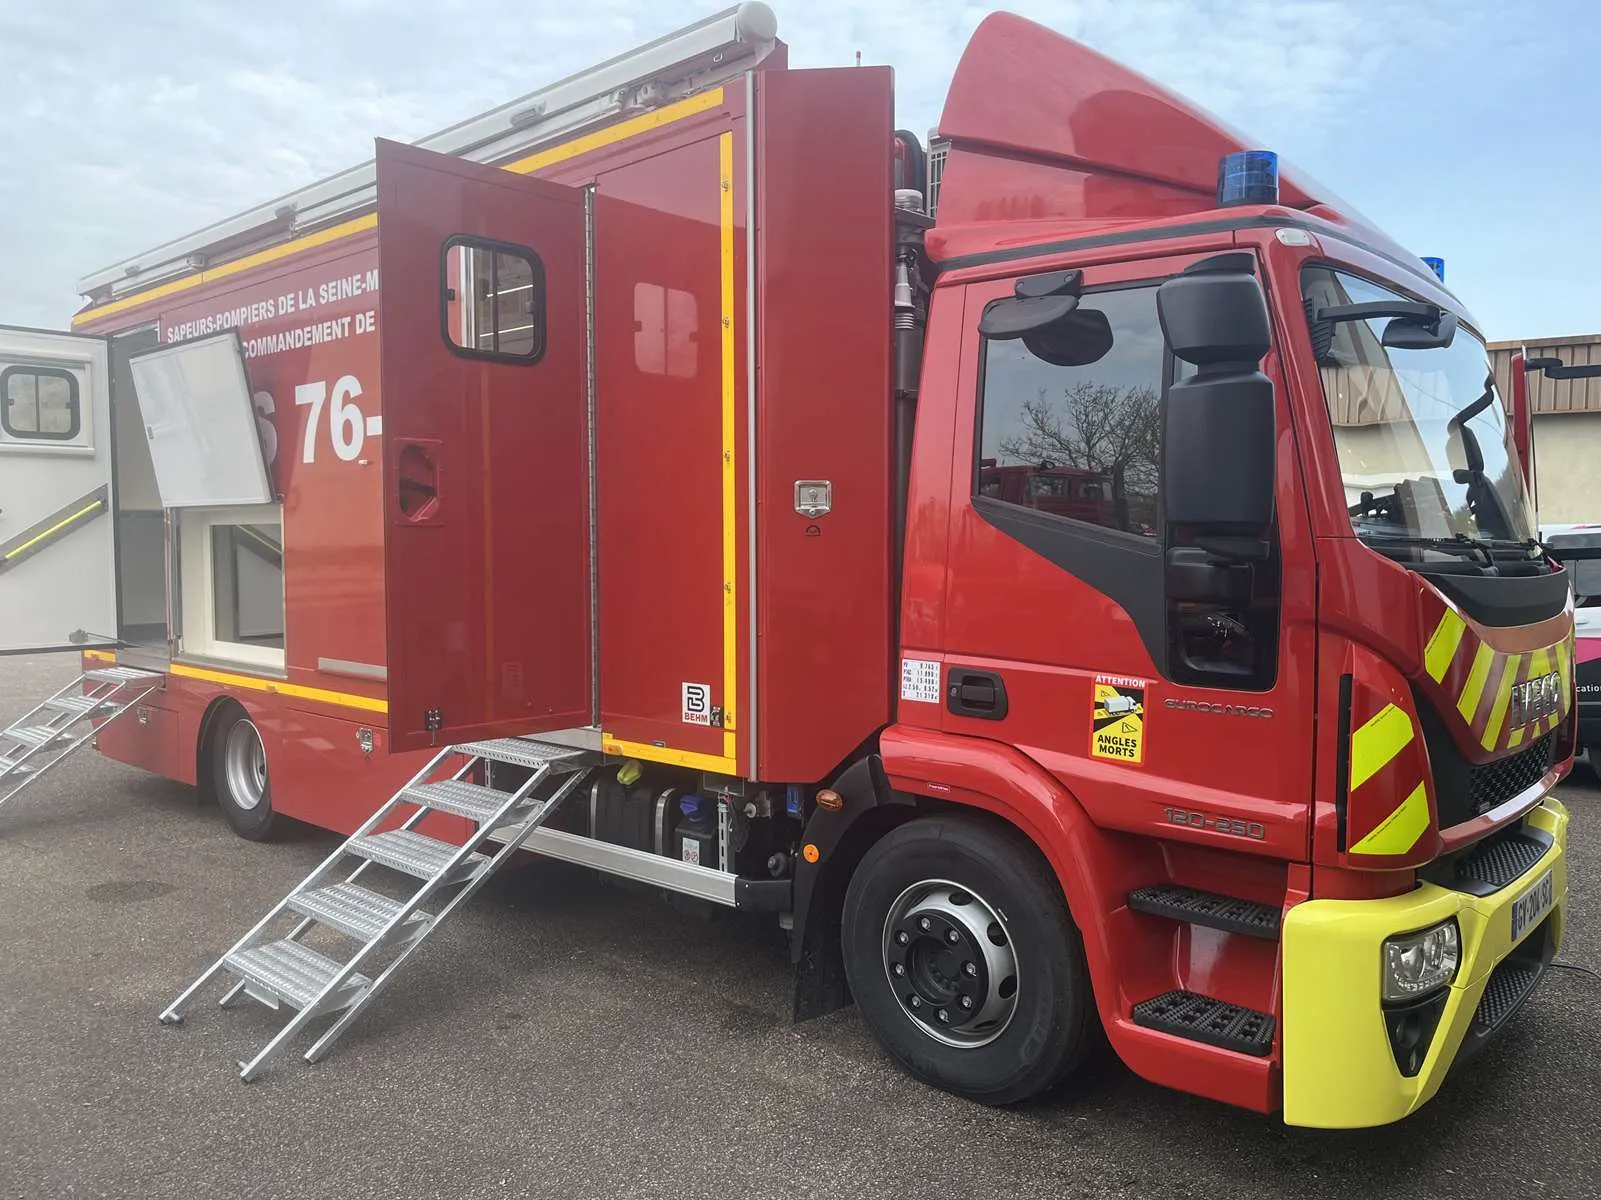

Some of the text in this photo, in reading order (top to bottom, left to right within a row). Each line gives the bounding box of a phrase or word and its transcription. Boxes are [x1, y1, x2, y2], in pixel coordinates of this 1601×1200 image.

[167, 301, 275, 344] SAPEURS-POMPIERS
[278, 293, 295, 316] DE
[299, 288, 316, 310] LA
[356, 311, 376, 334] DE
[1095, 675, 1146, 688] ATTENTION
[1575, 683, 1601, 693] catio
[684, 712, 707, 722] BEHM
[1097, 734, 1137, 748] ANGLES
[1099, 744, 1136, 758] MORTS
